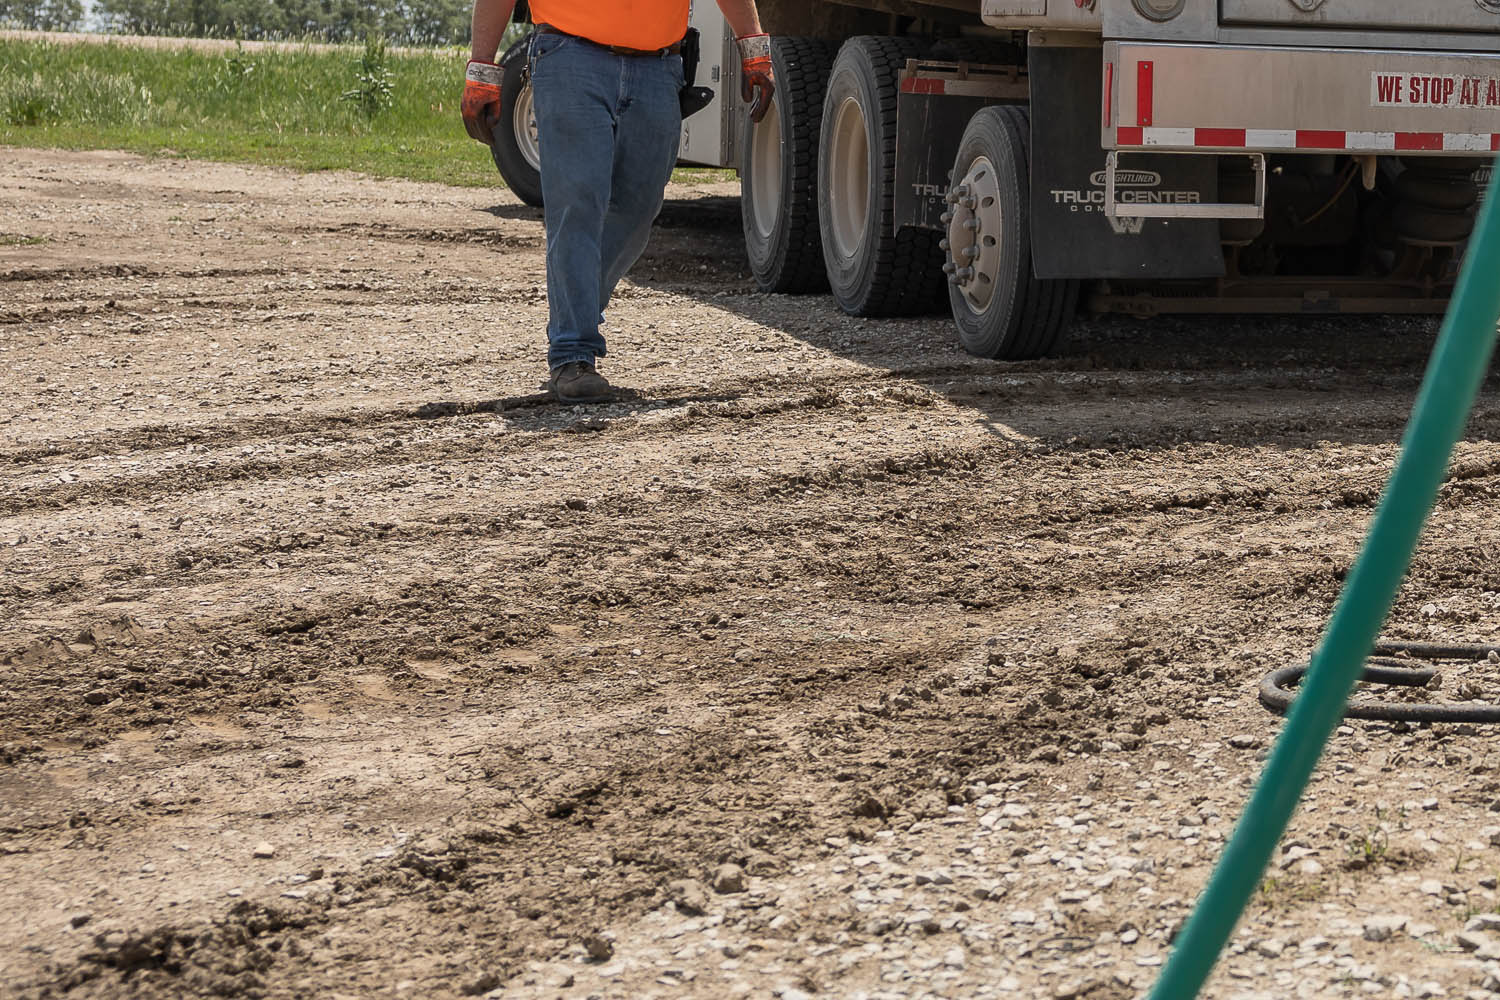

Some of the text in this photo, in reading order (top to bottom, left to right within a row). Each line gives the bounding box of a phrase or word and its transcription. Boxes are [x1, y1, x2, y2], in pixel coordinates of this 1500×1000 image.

[1377, 75, 1402, 103] WE
[1410, 76, 1454, 104] STOP
[1460, 77, 1480, 105] AT
[1097, 174, 1153, 182] FRGHTLINER
[912, 184, 948, 196] TRU
[1121, 191, 1200, 203] CENTER
